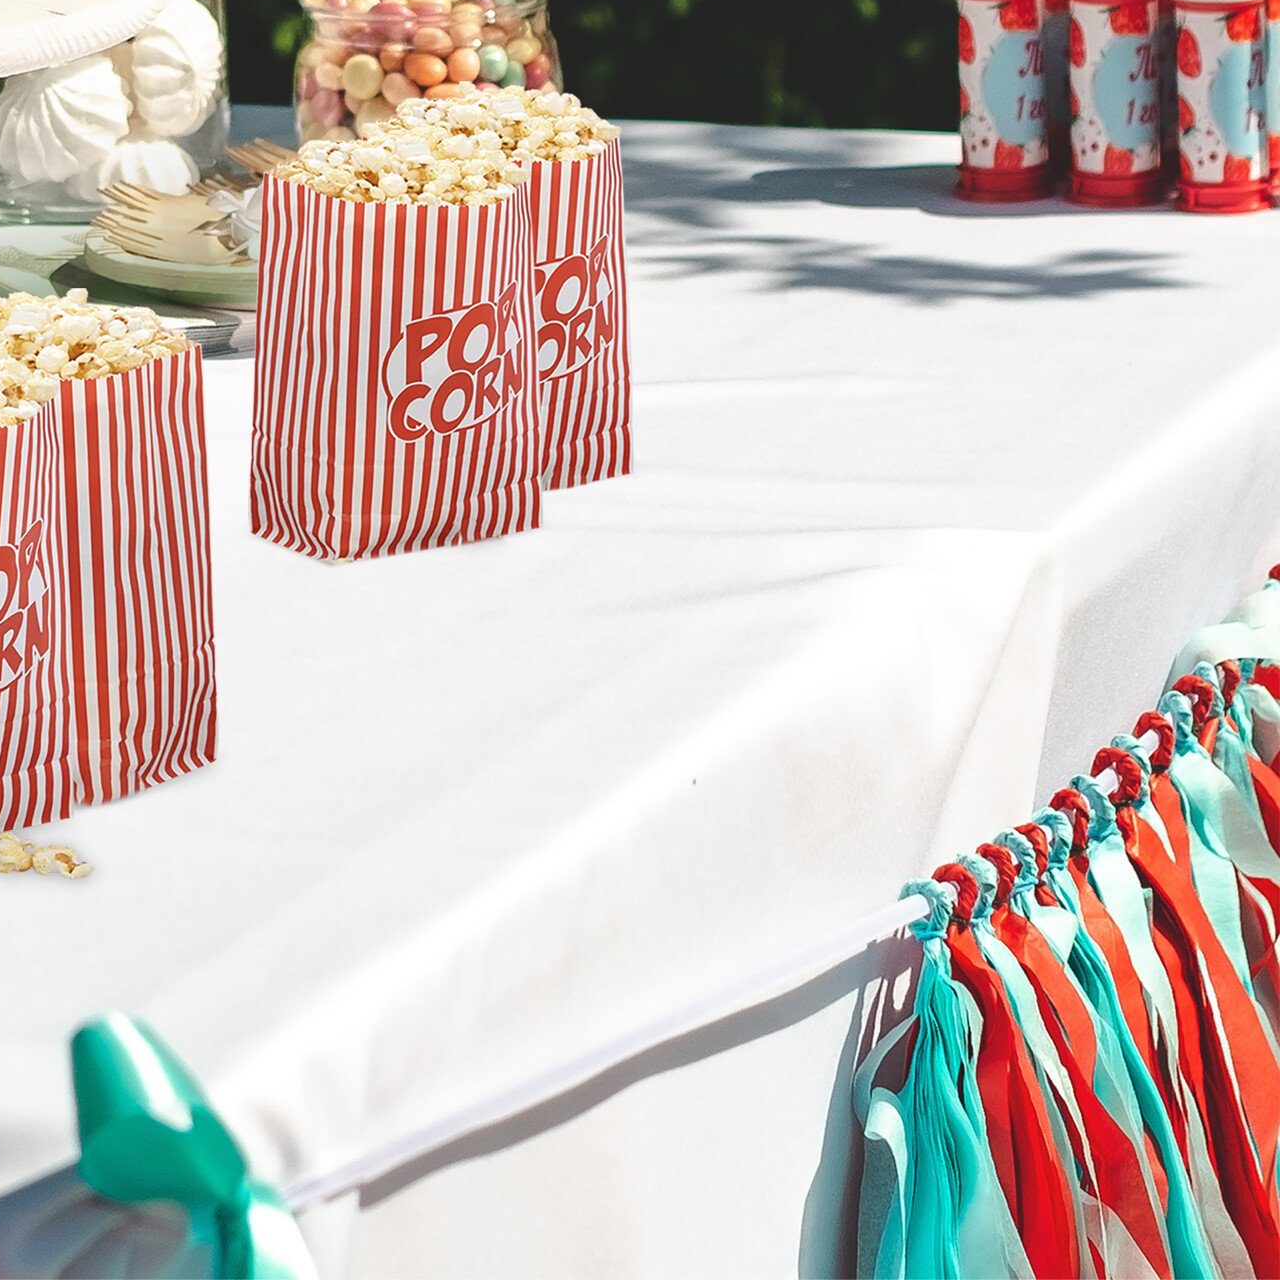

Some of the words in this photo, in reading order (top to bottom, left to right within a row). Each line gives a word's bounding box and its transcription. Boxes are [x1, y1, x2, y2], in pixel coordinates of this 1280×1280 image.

[534, 234, 608, 324] OP
[406, 281, 517, 384] POP
[537, 290, 614, 383] ORN
[389, 338, 523, 442] CORN
